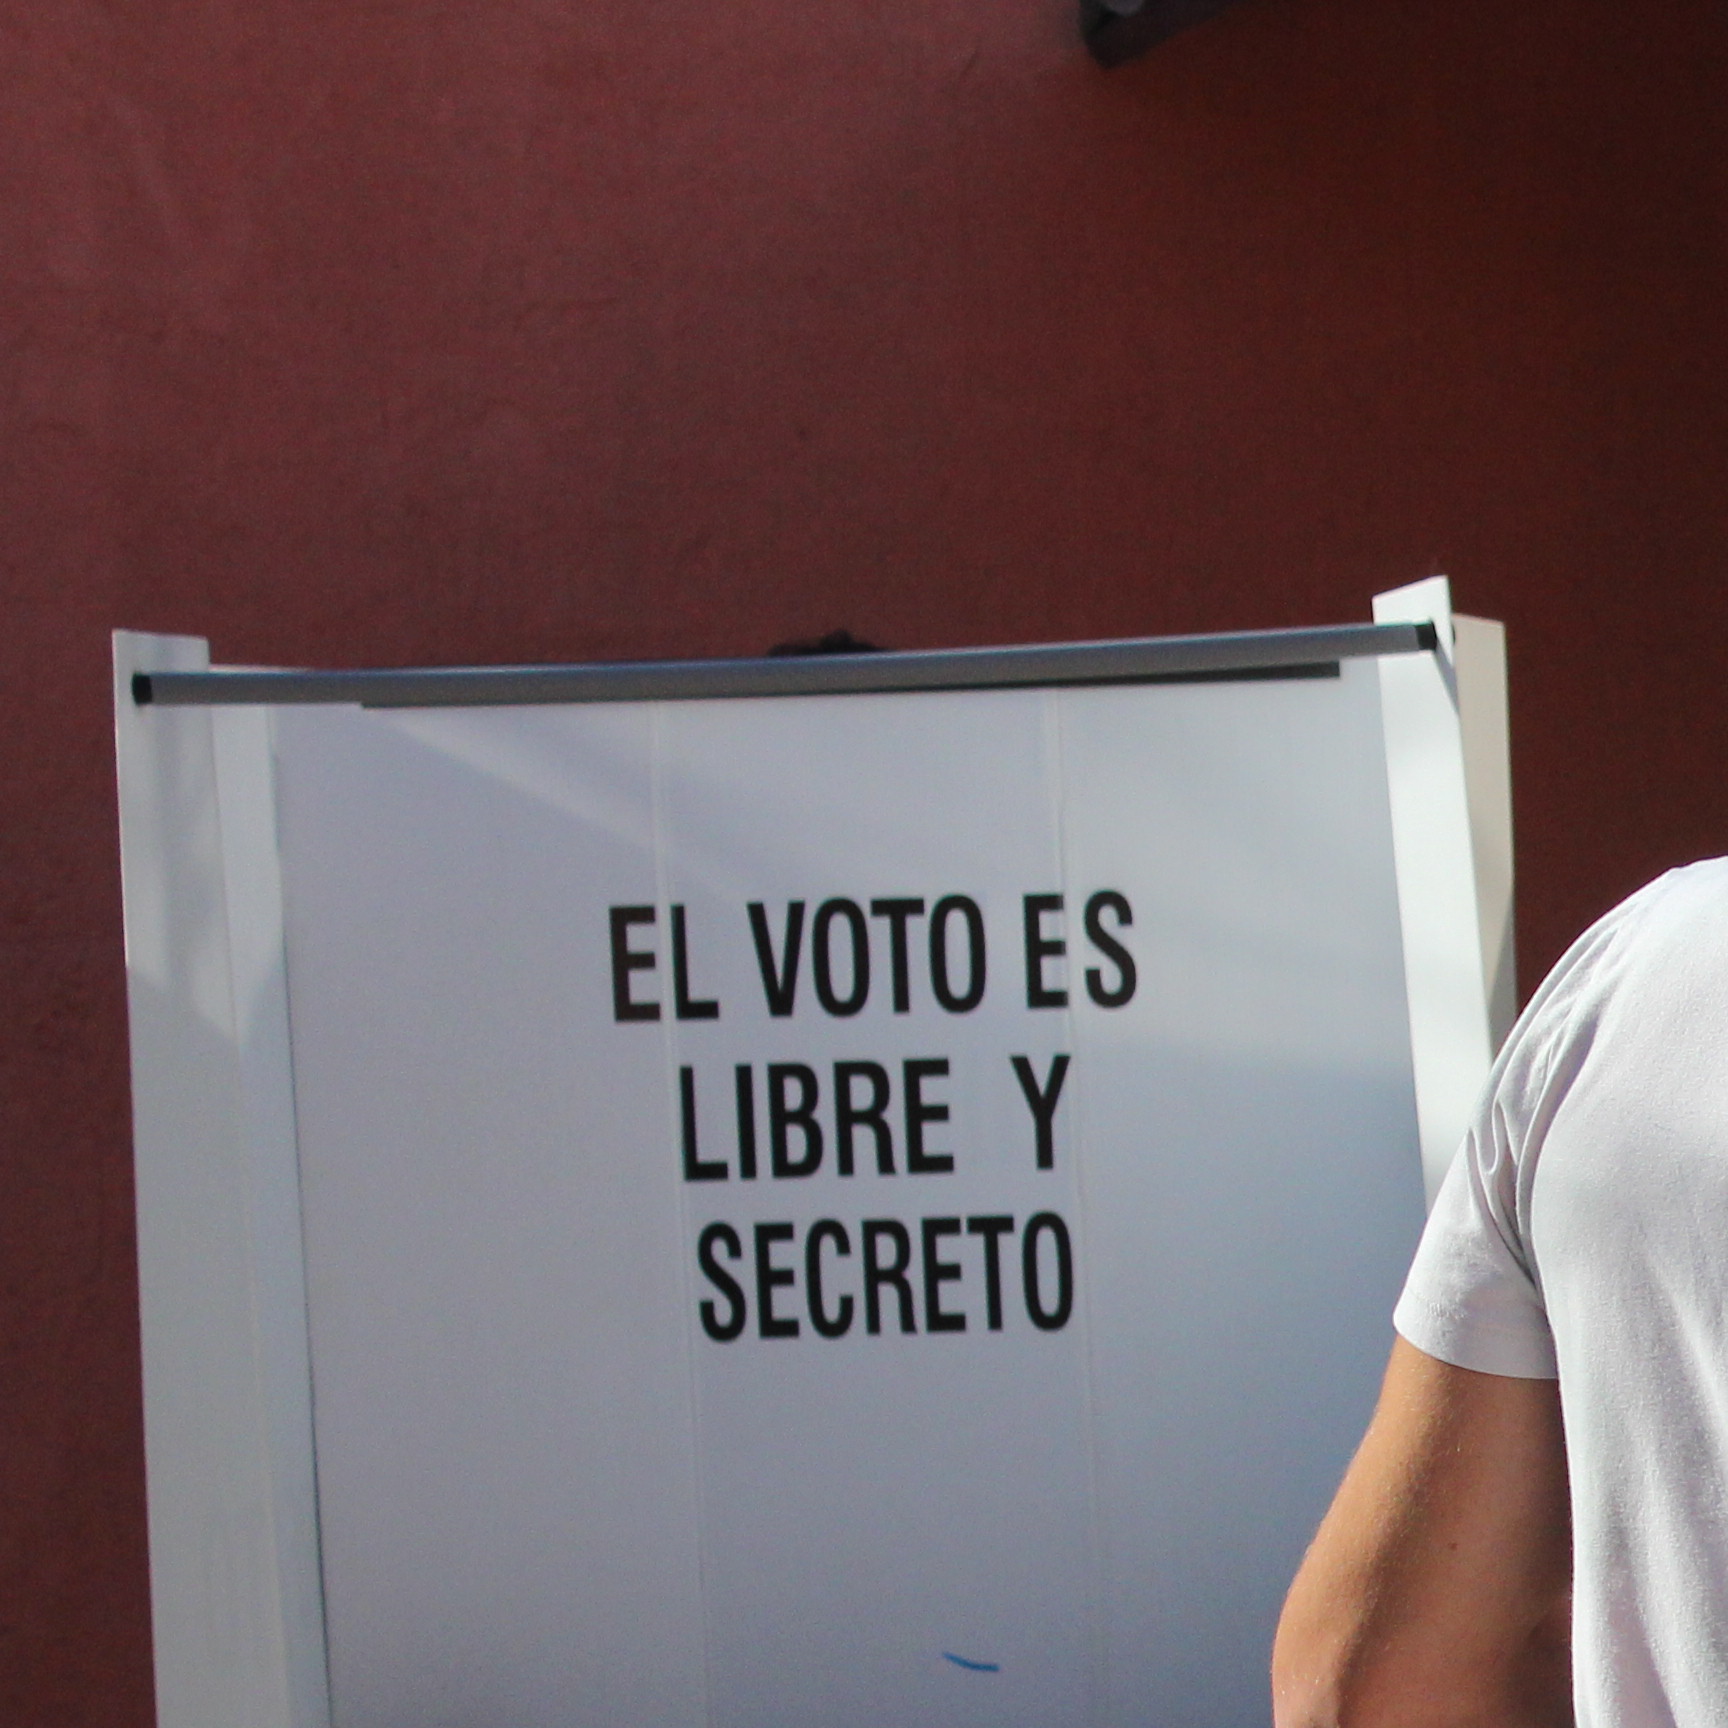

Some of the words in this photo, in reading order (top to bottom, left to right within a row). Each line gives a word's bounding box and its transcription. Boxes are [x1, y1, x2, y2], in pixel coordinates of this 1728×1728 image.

[608, 904, 719, 1022] EL
[747, 894, 987, 1018] VOTO
[1022, 889, 1138, 1009] ES
[678, 1057, 955, 1182] LIBRE
[1010, 1054, 1071, 1170] Y
[697, 1211, 1074, 1342] SECRETO
